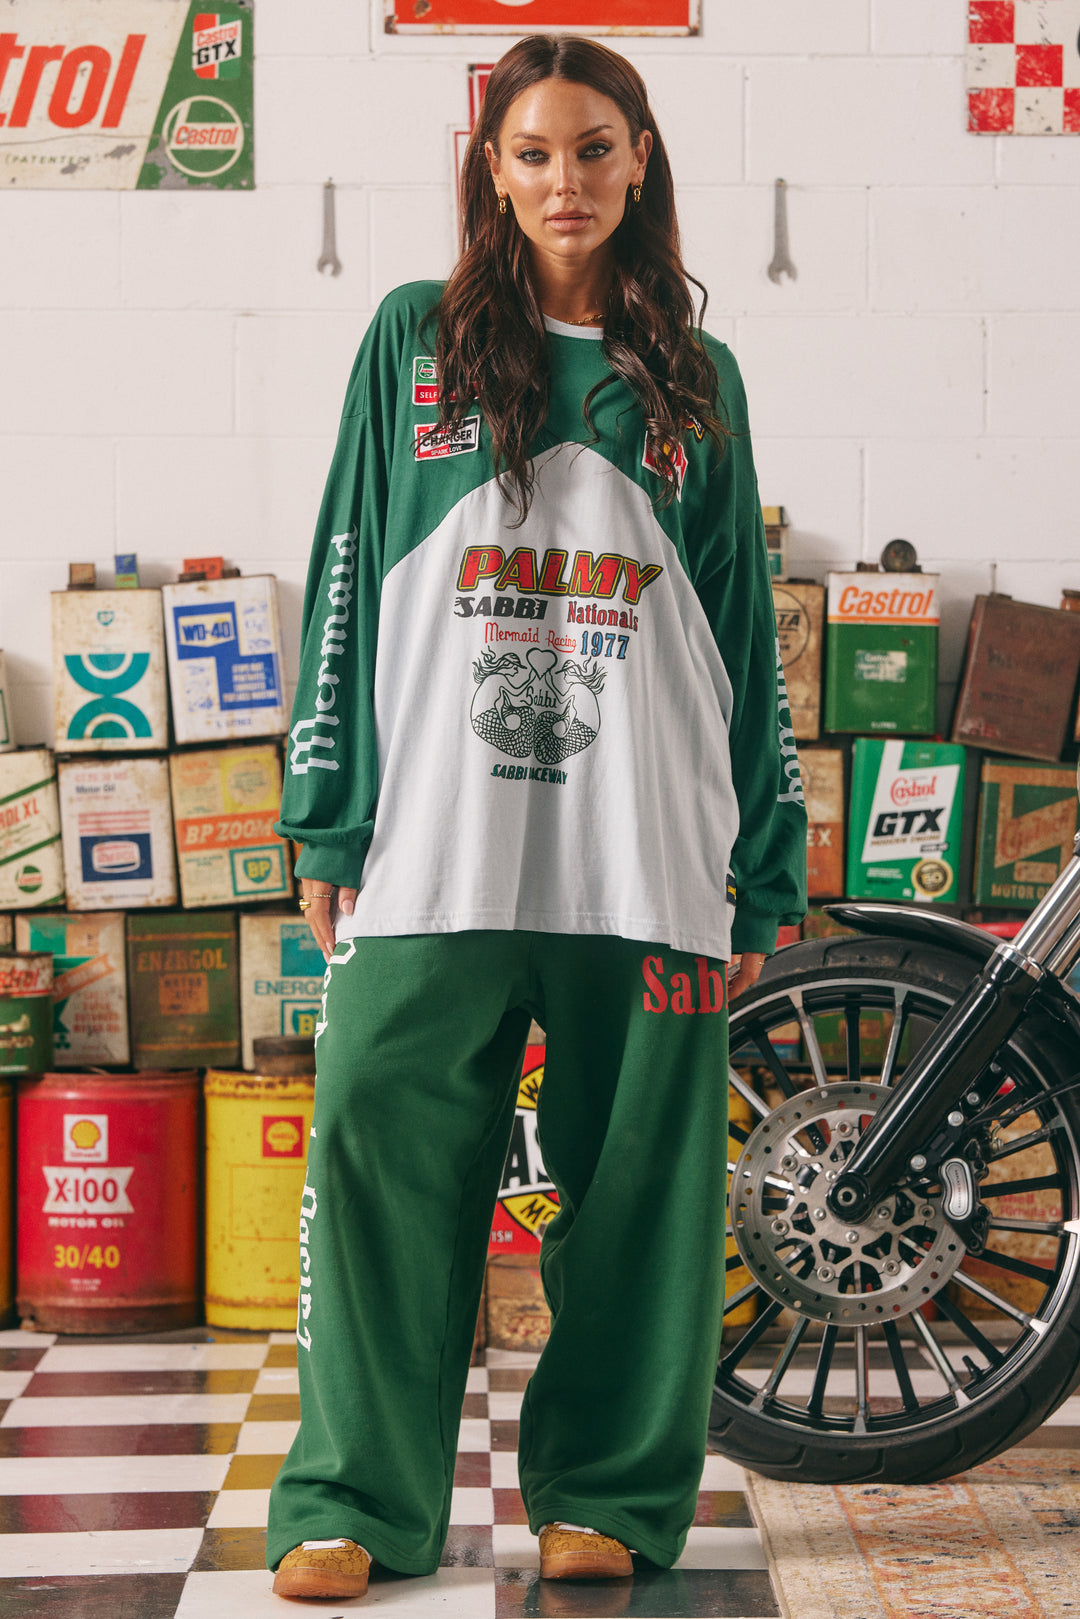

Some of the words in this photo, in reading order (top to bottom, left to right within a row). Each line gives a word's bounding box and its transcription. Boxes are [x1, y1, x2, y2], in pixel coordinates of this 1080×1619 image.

[196, 25, 239, 48] Castrol
[197, 39, 237, 66] GTX
[175, 125, 239, 146] Castrol
[421, 429, 473, 447] CHANGER
[430, 448, 449, 456] SPARK
[457, 545, 663, 605] PALMY
[838, 586, 934, 616] Castrol
[454, 596, 549, 620] SABBI
[567, 601, 639, 632] Nationals
[182, 621, 232, 642] WD-40
[485, 622, 540, 644] Mermaid
[545, 629, 577, 653] Racing
[289, 522, 359, 776] Mermaid
[580, 630, 630, 660] 1977
[490, 764, 528, 780] SABBI
[890, 774, 938, 807] Castrol
[185, 823, 214, 845] BP
[215, 818, 275, 842] ZOOM
[873, 806, 946, 837] GTX
[247, 860, 271, 879] BP
[991, 883, 1034, 899] MOTOR
[137, 949, 228, 972] ENERGOL
[642, 955, 728, 1014] Sab
[54, 1178, 118, 1203] X-100
[48, 1217, 97, 1228] MOTOR
[101, 1217, 125, 1228] OIL
[54, 1244, 120, 1269] 30/40
